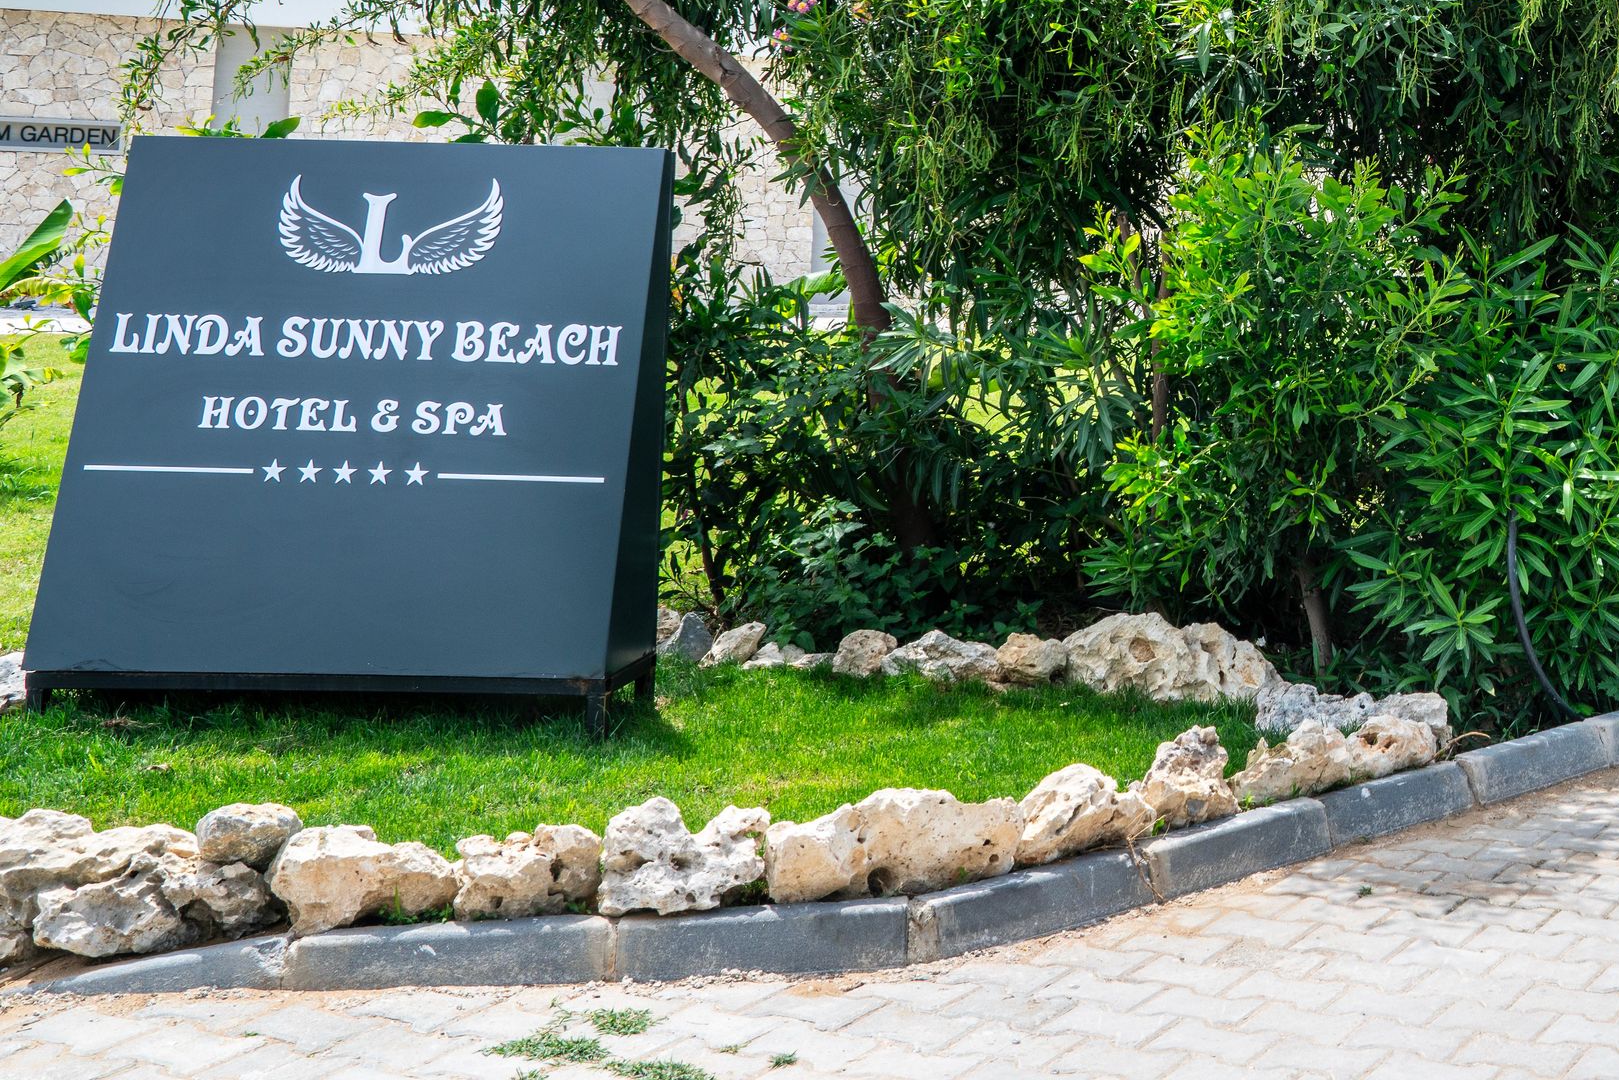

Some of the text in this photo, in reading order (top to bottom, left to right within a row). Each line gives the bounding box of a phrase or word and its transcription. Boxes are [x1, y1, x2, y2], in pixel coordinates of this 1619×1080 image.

[20, 125, 117, 146] GARDEN
[109, 312, 623, 366] LINDA SUNNY BEACH
[197, 396, 507, 437] HOTEL & SPA
